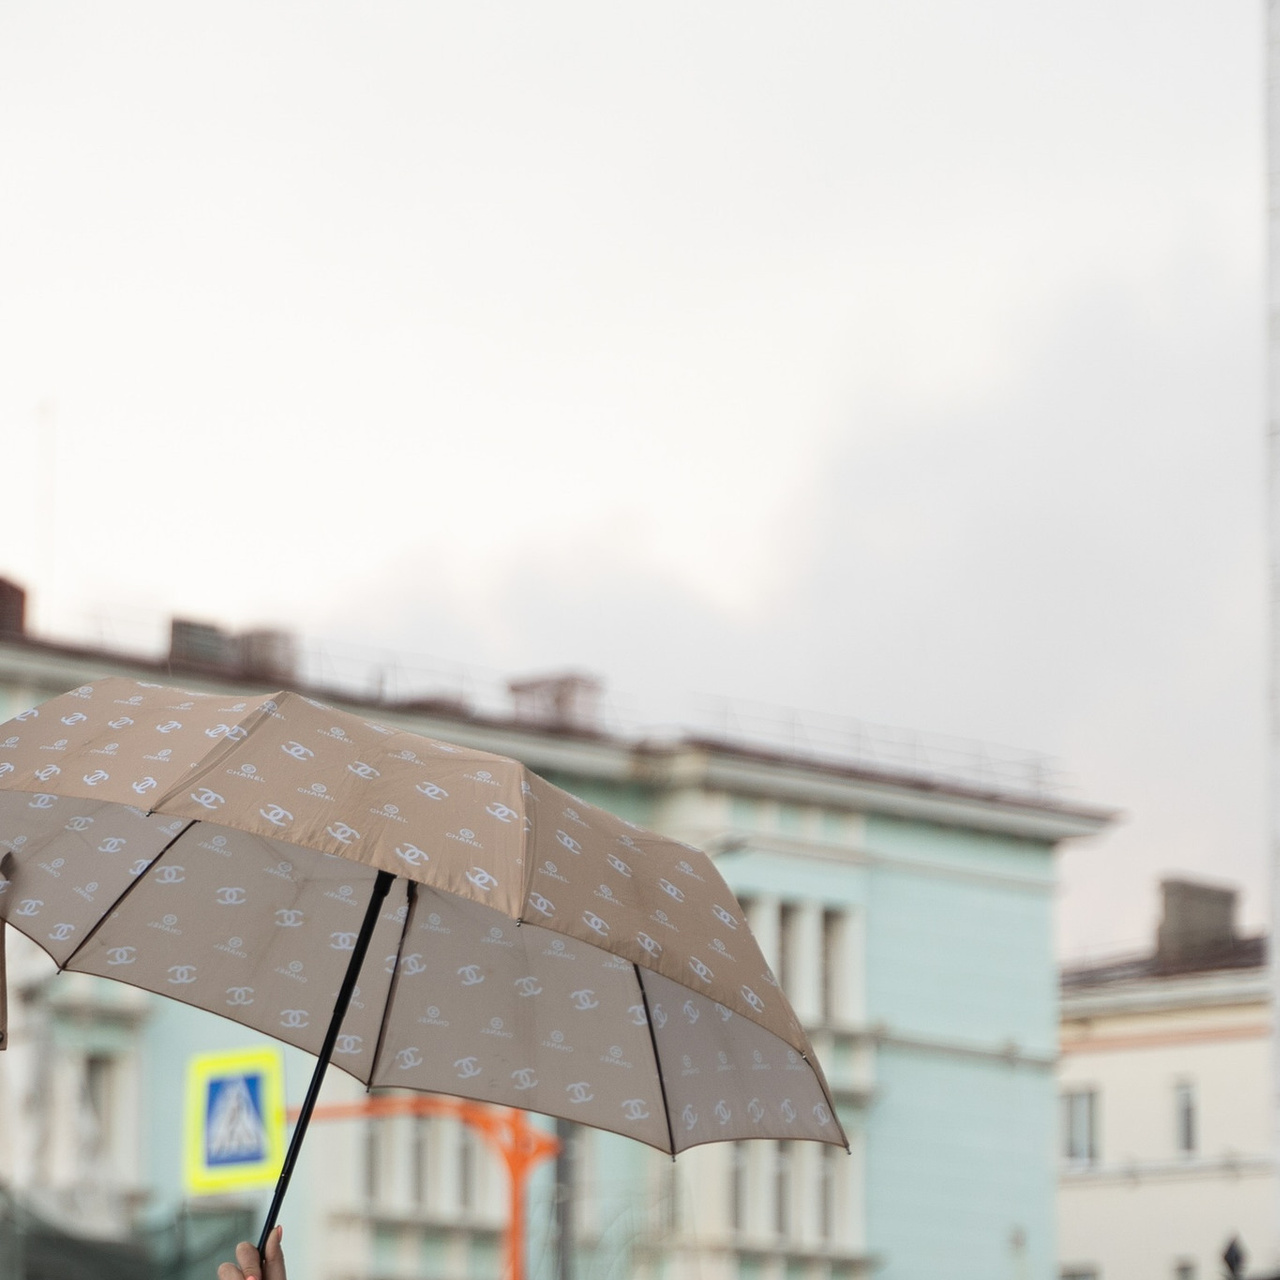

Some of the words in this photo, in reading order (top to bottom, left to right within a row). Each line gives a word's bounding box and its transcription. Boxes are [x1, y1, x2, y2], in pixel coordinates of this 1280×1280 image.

[317, 729, 353, 744] CHANEL
[388, 753, 426, 766] CHANEL
[226, 769, 266, 783] CHANEL
[463, 773, 502, 787] CHANEL
[297, 787, 336, 802] CHANEL
[370, 808, 408, 824] CHANEL
[446, 832, 484, 849] CHANEL
[538, 867, 570, 884] CHANEL
